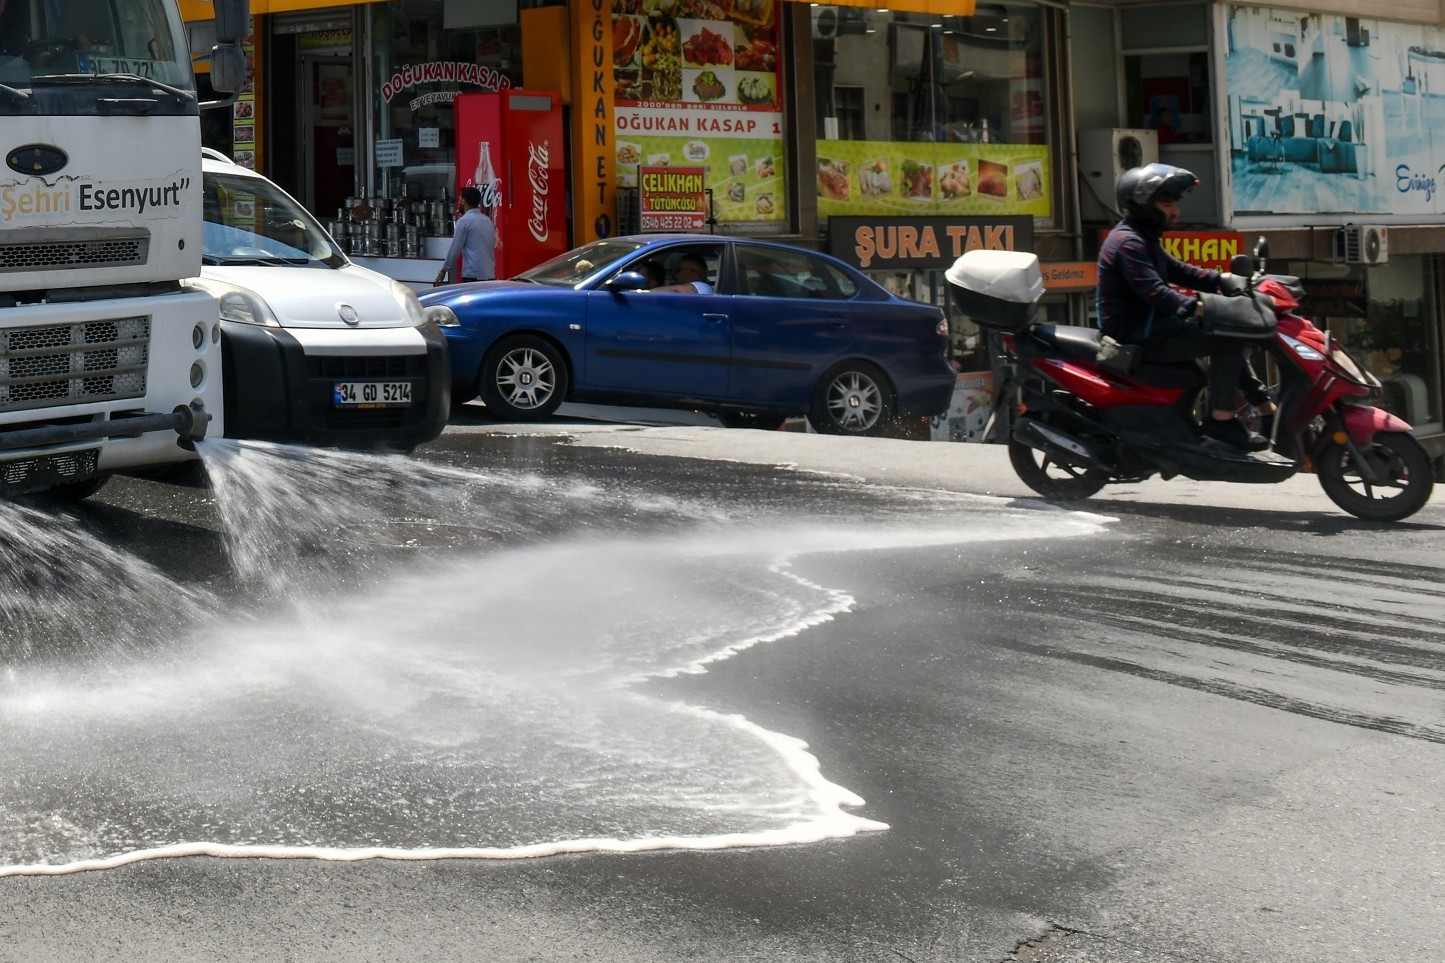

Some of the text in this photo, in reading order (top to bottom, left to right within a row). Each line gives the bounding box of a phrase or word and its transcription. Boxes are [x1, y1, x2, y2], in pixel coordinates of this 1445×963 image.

[381, 62, 455, 104] DOĞUKAN
[410, 97, 423, 111] ET
[421, 94, 433, 107] VE
[615, 113, 782, 134] OĞUKAN KASAP 1
[527, 139, 550, 243] Coca-Cola
[641, 170, 704, 197] ÇELİKHAN
[1, 185, 71, 223] Şehri
[78, 177, 190, 215] Esenyurt"
[649, 196, 697, 213] TÜTÜNCÜSÜ
[641, 216, 693, 230] 0546 425 22 02
[854, 224, 1016, 268] ŞURA TAKI
[1160, 237, 1238, 263] KHAN
[341, 383, 410, 402] 34 GD 5214
